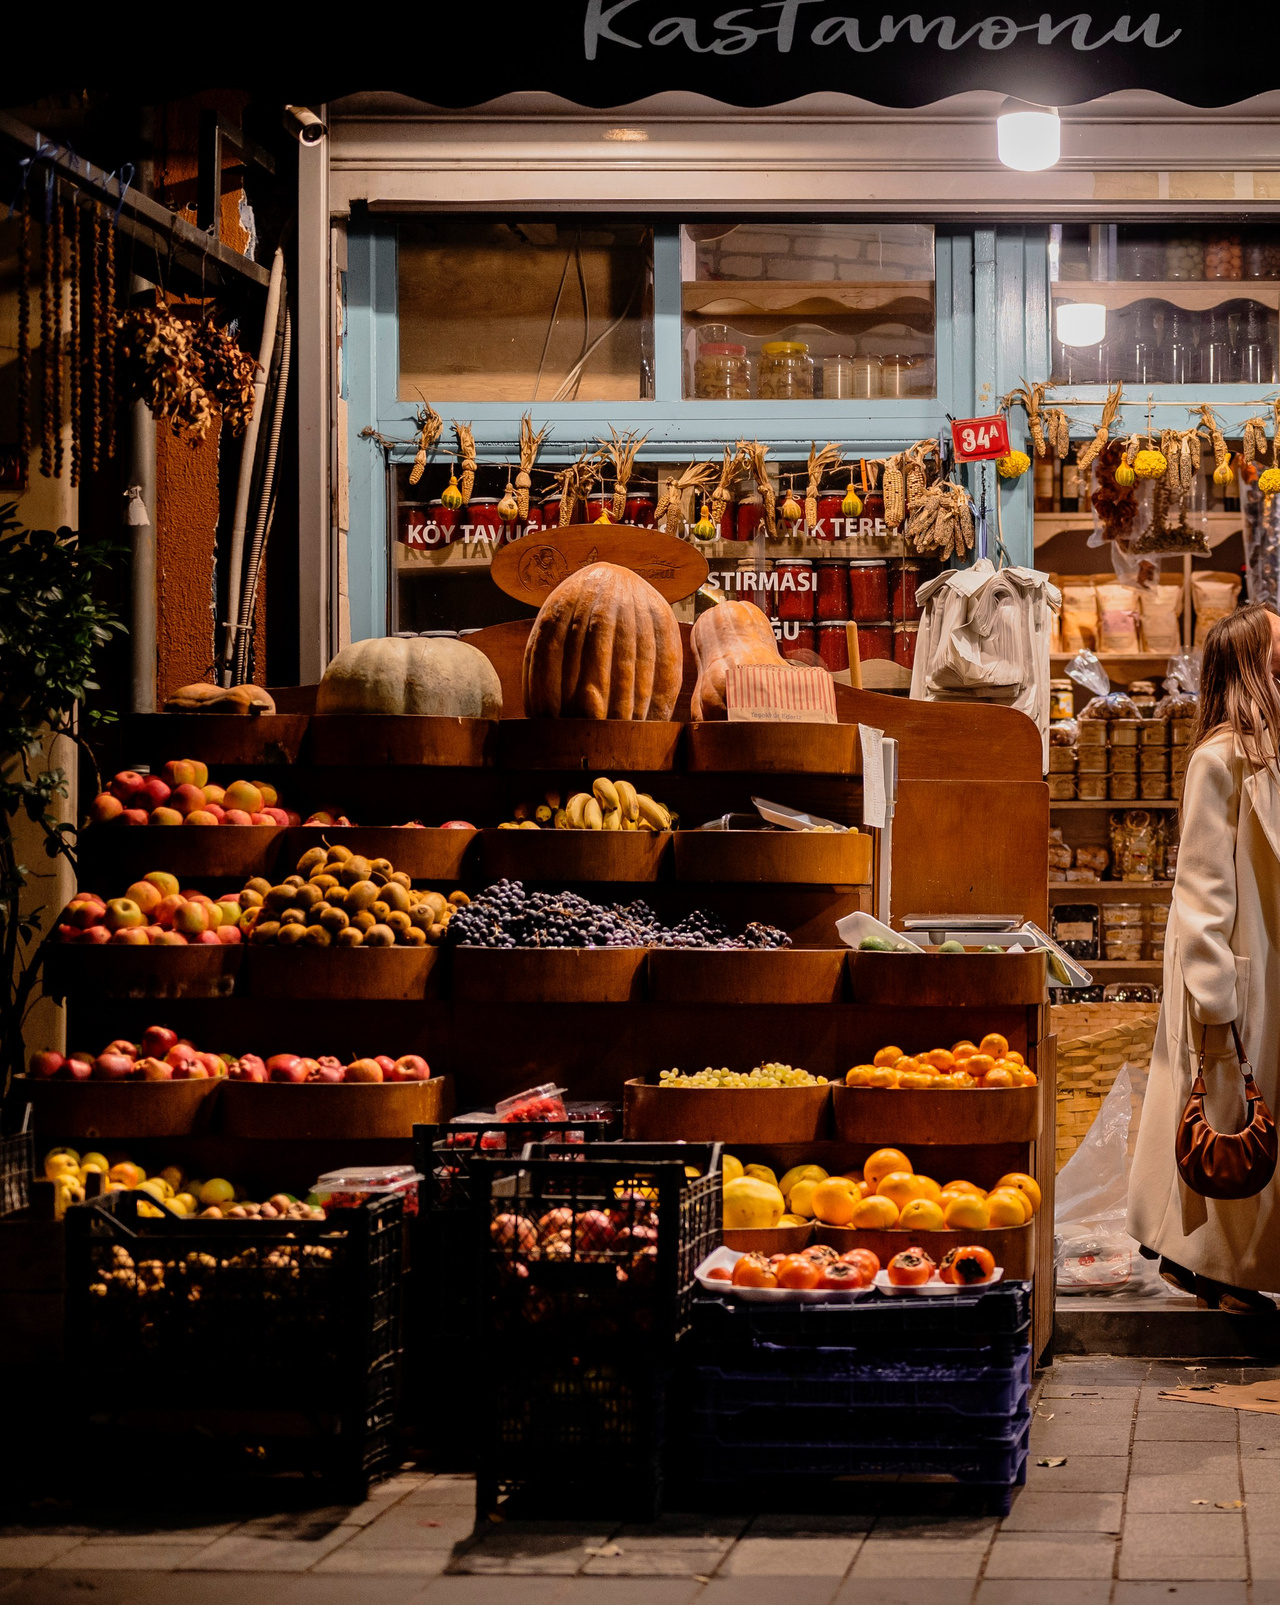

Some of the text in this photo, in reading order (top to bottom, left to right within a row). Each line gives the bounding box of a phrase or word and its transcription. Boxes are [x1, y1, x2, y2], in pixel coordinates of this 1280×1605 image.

[584, 0, 1182, 60] Kastamonu
[962, 425, 999, 452] 34A
[408, 520, 456, 543] KÖY
